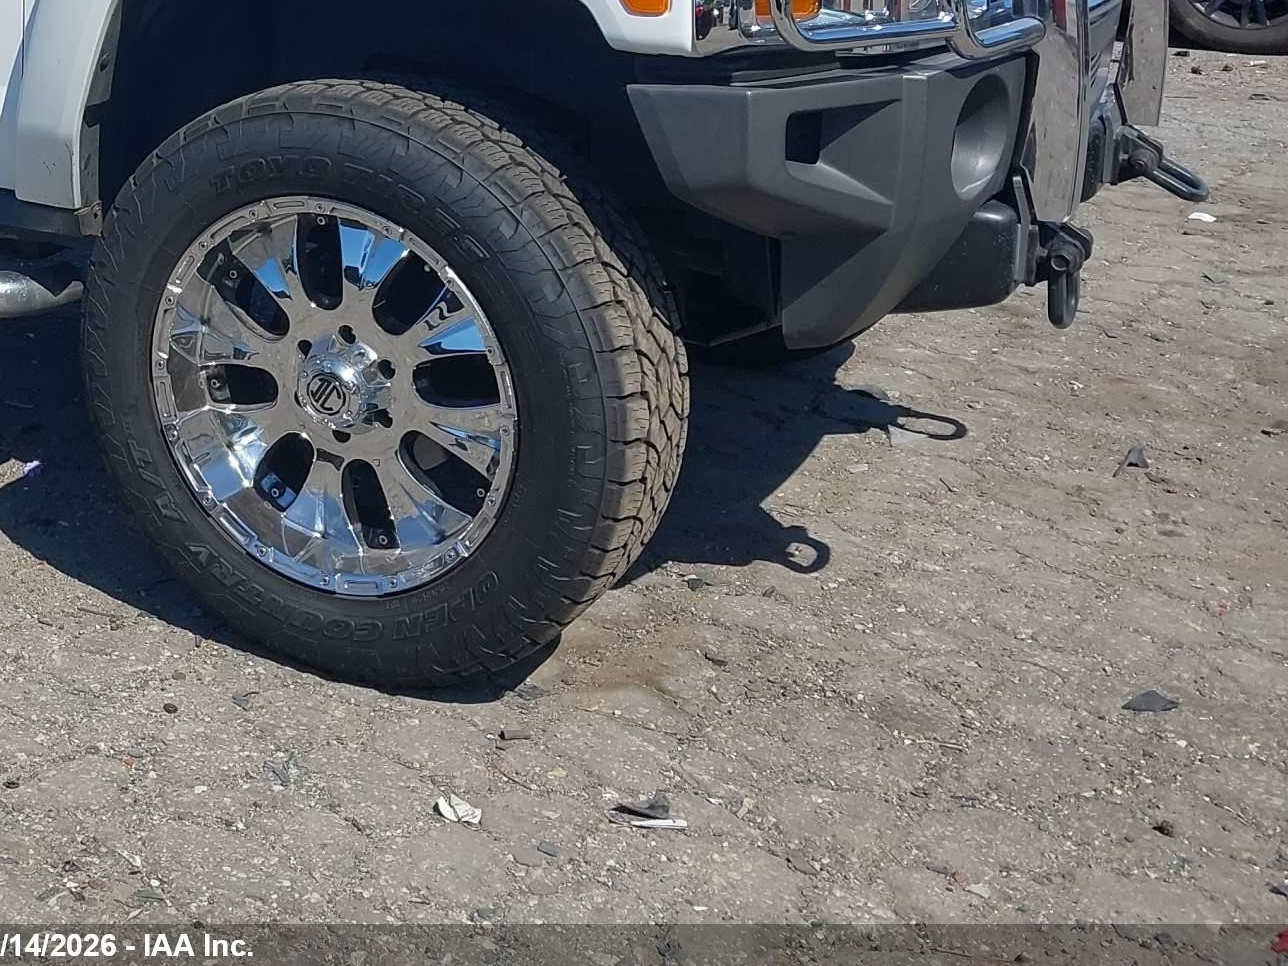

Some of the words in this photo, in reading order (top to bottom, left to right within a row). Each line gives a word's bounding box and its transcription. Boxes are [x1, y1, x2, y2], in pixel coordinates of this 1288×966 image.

[210, 155, 332, 195] TOYO
[184, 541, 384, 642] COUNTRY
[391, 570, 500, 640] OPEN
